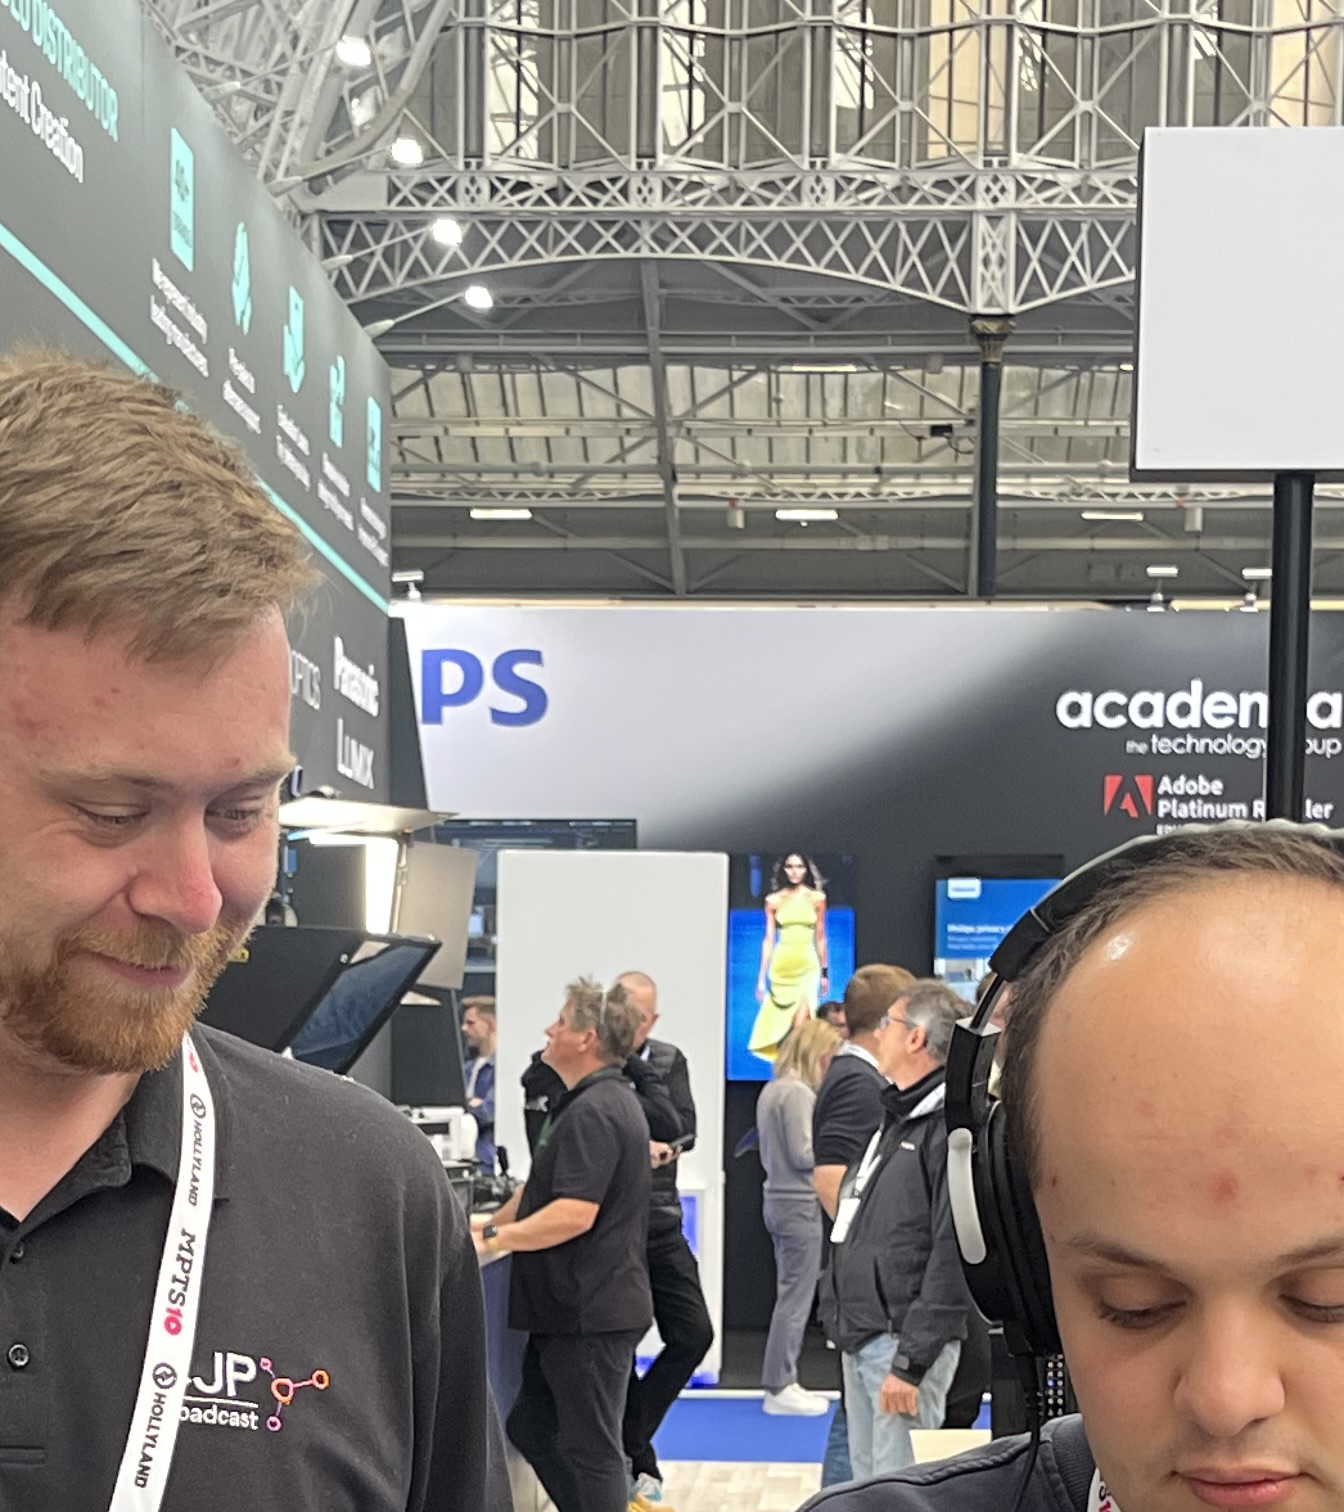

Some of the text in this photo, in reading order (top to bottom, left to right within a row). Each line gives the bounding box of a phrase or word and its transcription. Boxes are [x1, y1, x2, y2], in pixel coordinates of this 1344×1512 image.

[1157, 775, 1224, 796] Adobe
[1157, 798, 1248, 819] Platinum
[187, 1118, 207, 1207] HOLLYLAND
[191, 1351, 257, 1397] JP
[179, 1404, 259, 1431] oadcast
[134, 1392, 167, 1489] HOLLYLAND
